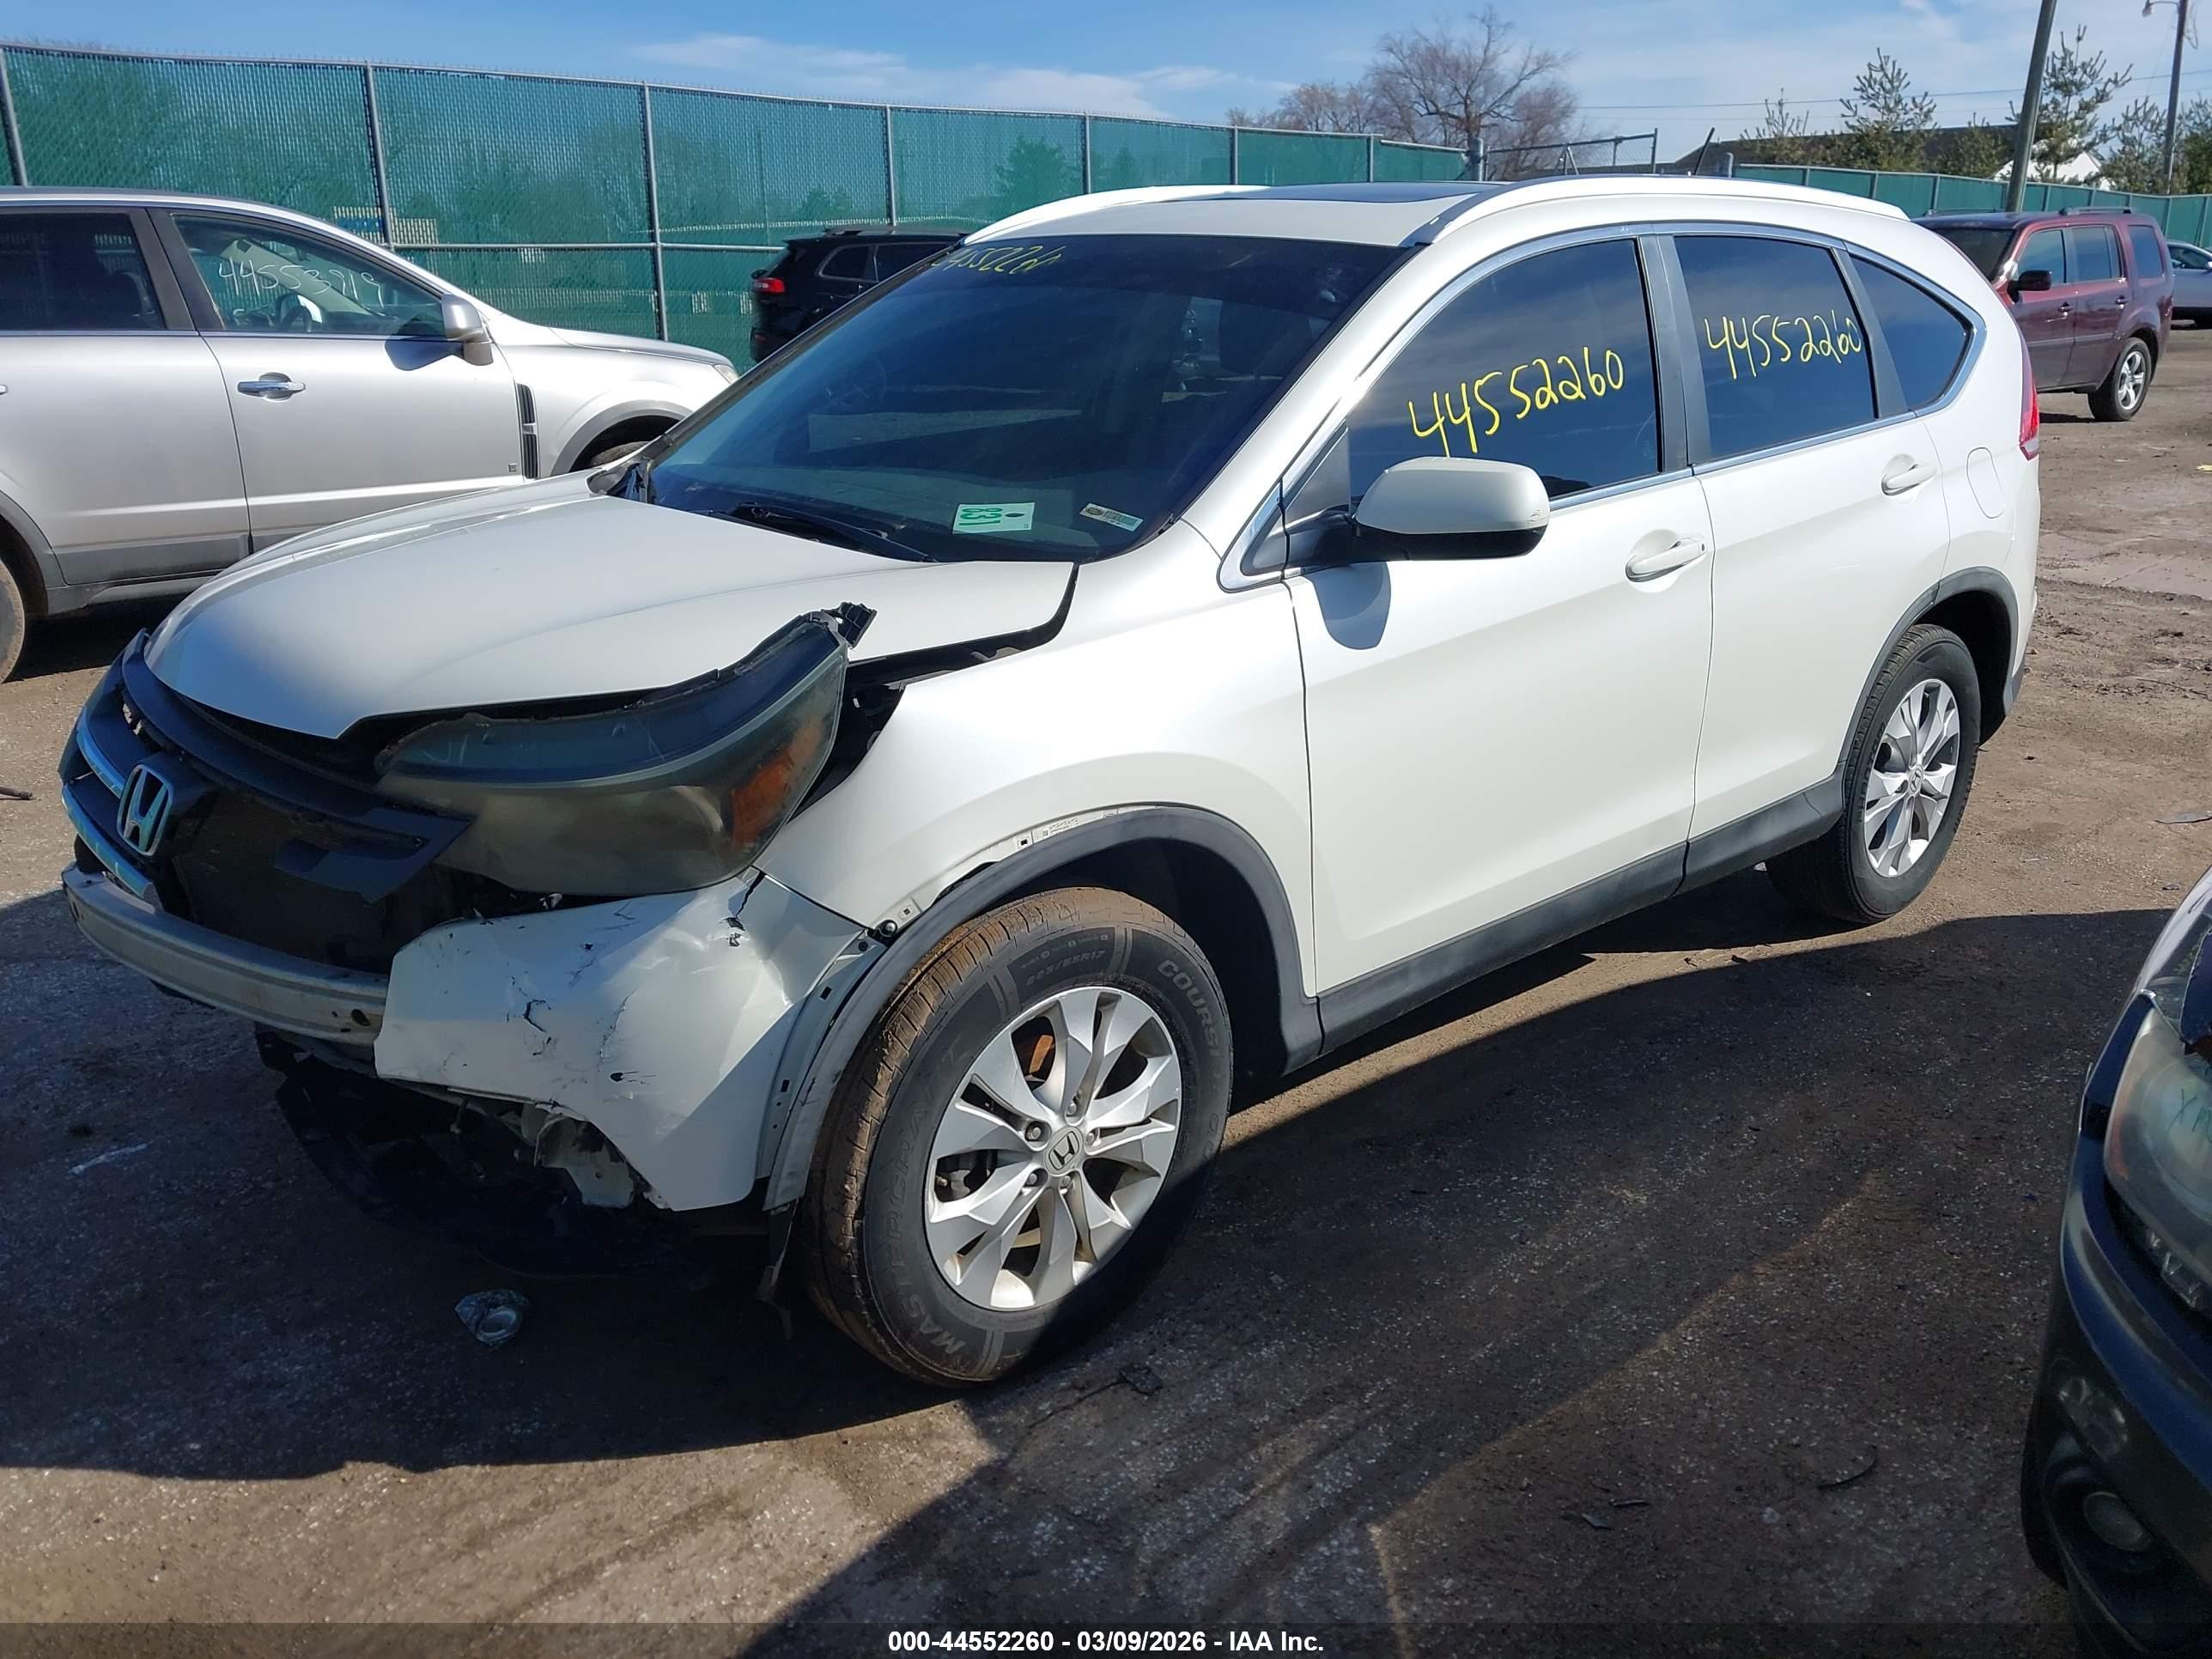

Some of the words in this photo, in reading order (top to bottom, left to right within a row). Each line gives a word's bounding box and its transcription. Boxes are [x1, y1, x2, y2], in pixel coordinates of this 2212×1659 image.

[1705, 309, 1864, 380] 44552260
[1407, 346, 1626, 459] 44552260
[958, 507, 1004, 526] 831
